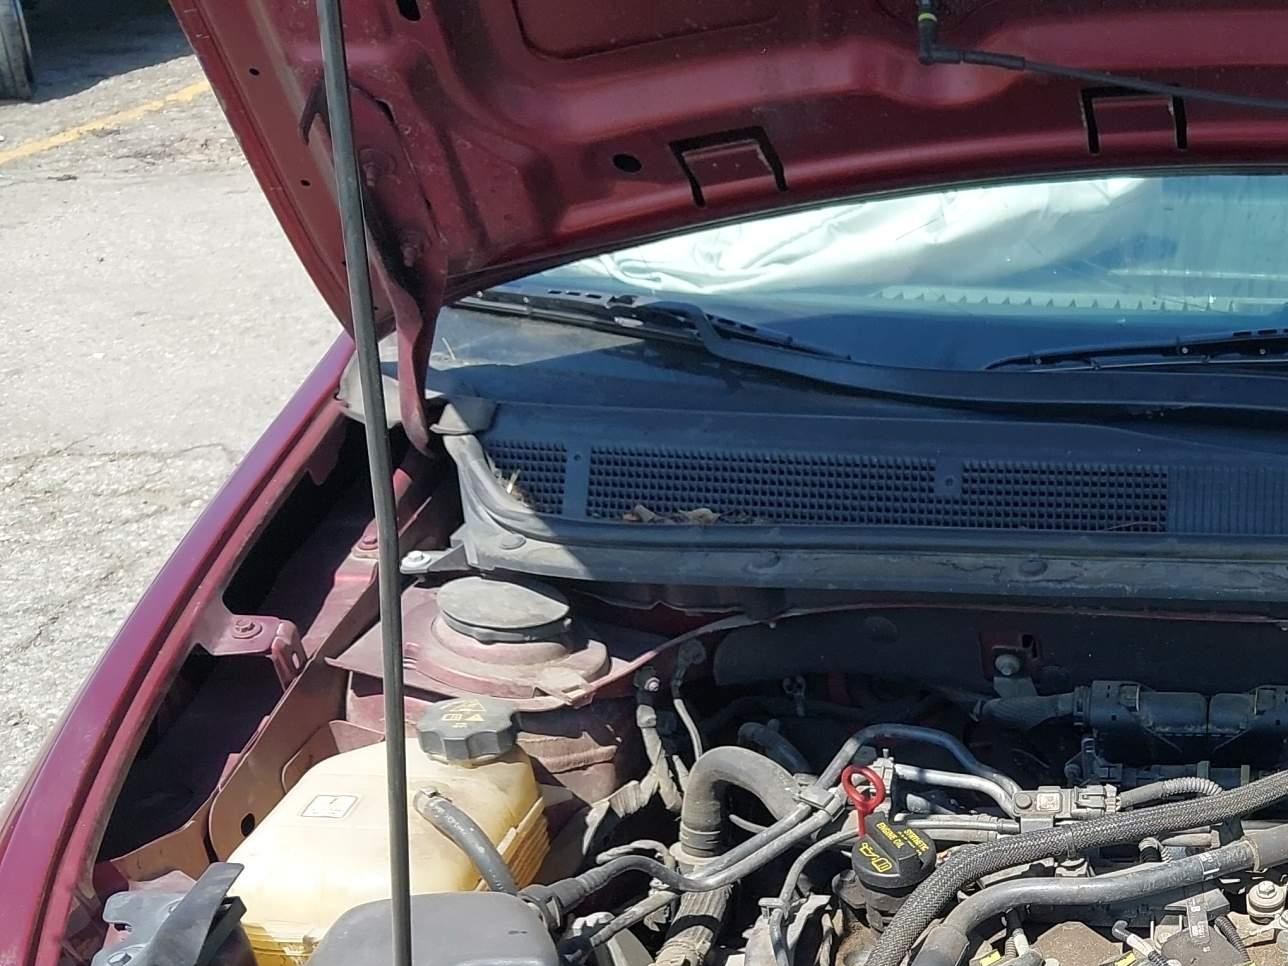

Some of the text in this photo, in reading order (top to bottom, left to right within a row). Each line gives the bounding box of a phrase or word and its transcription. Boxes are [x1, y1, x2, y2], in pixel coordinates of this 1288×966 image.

[876, 821, 905, 849] ENGINE OIL
[904, 828, 930, 852] SYNTHETIC
